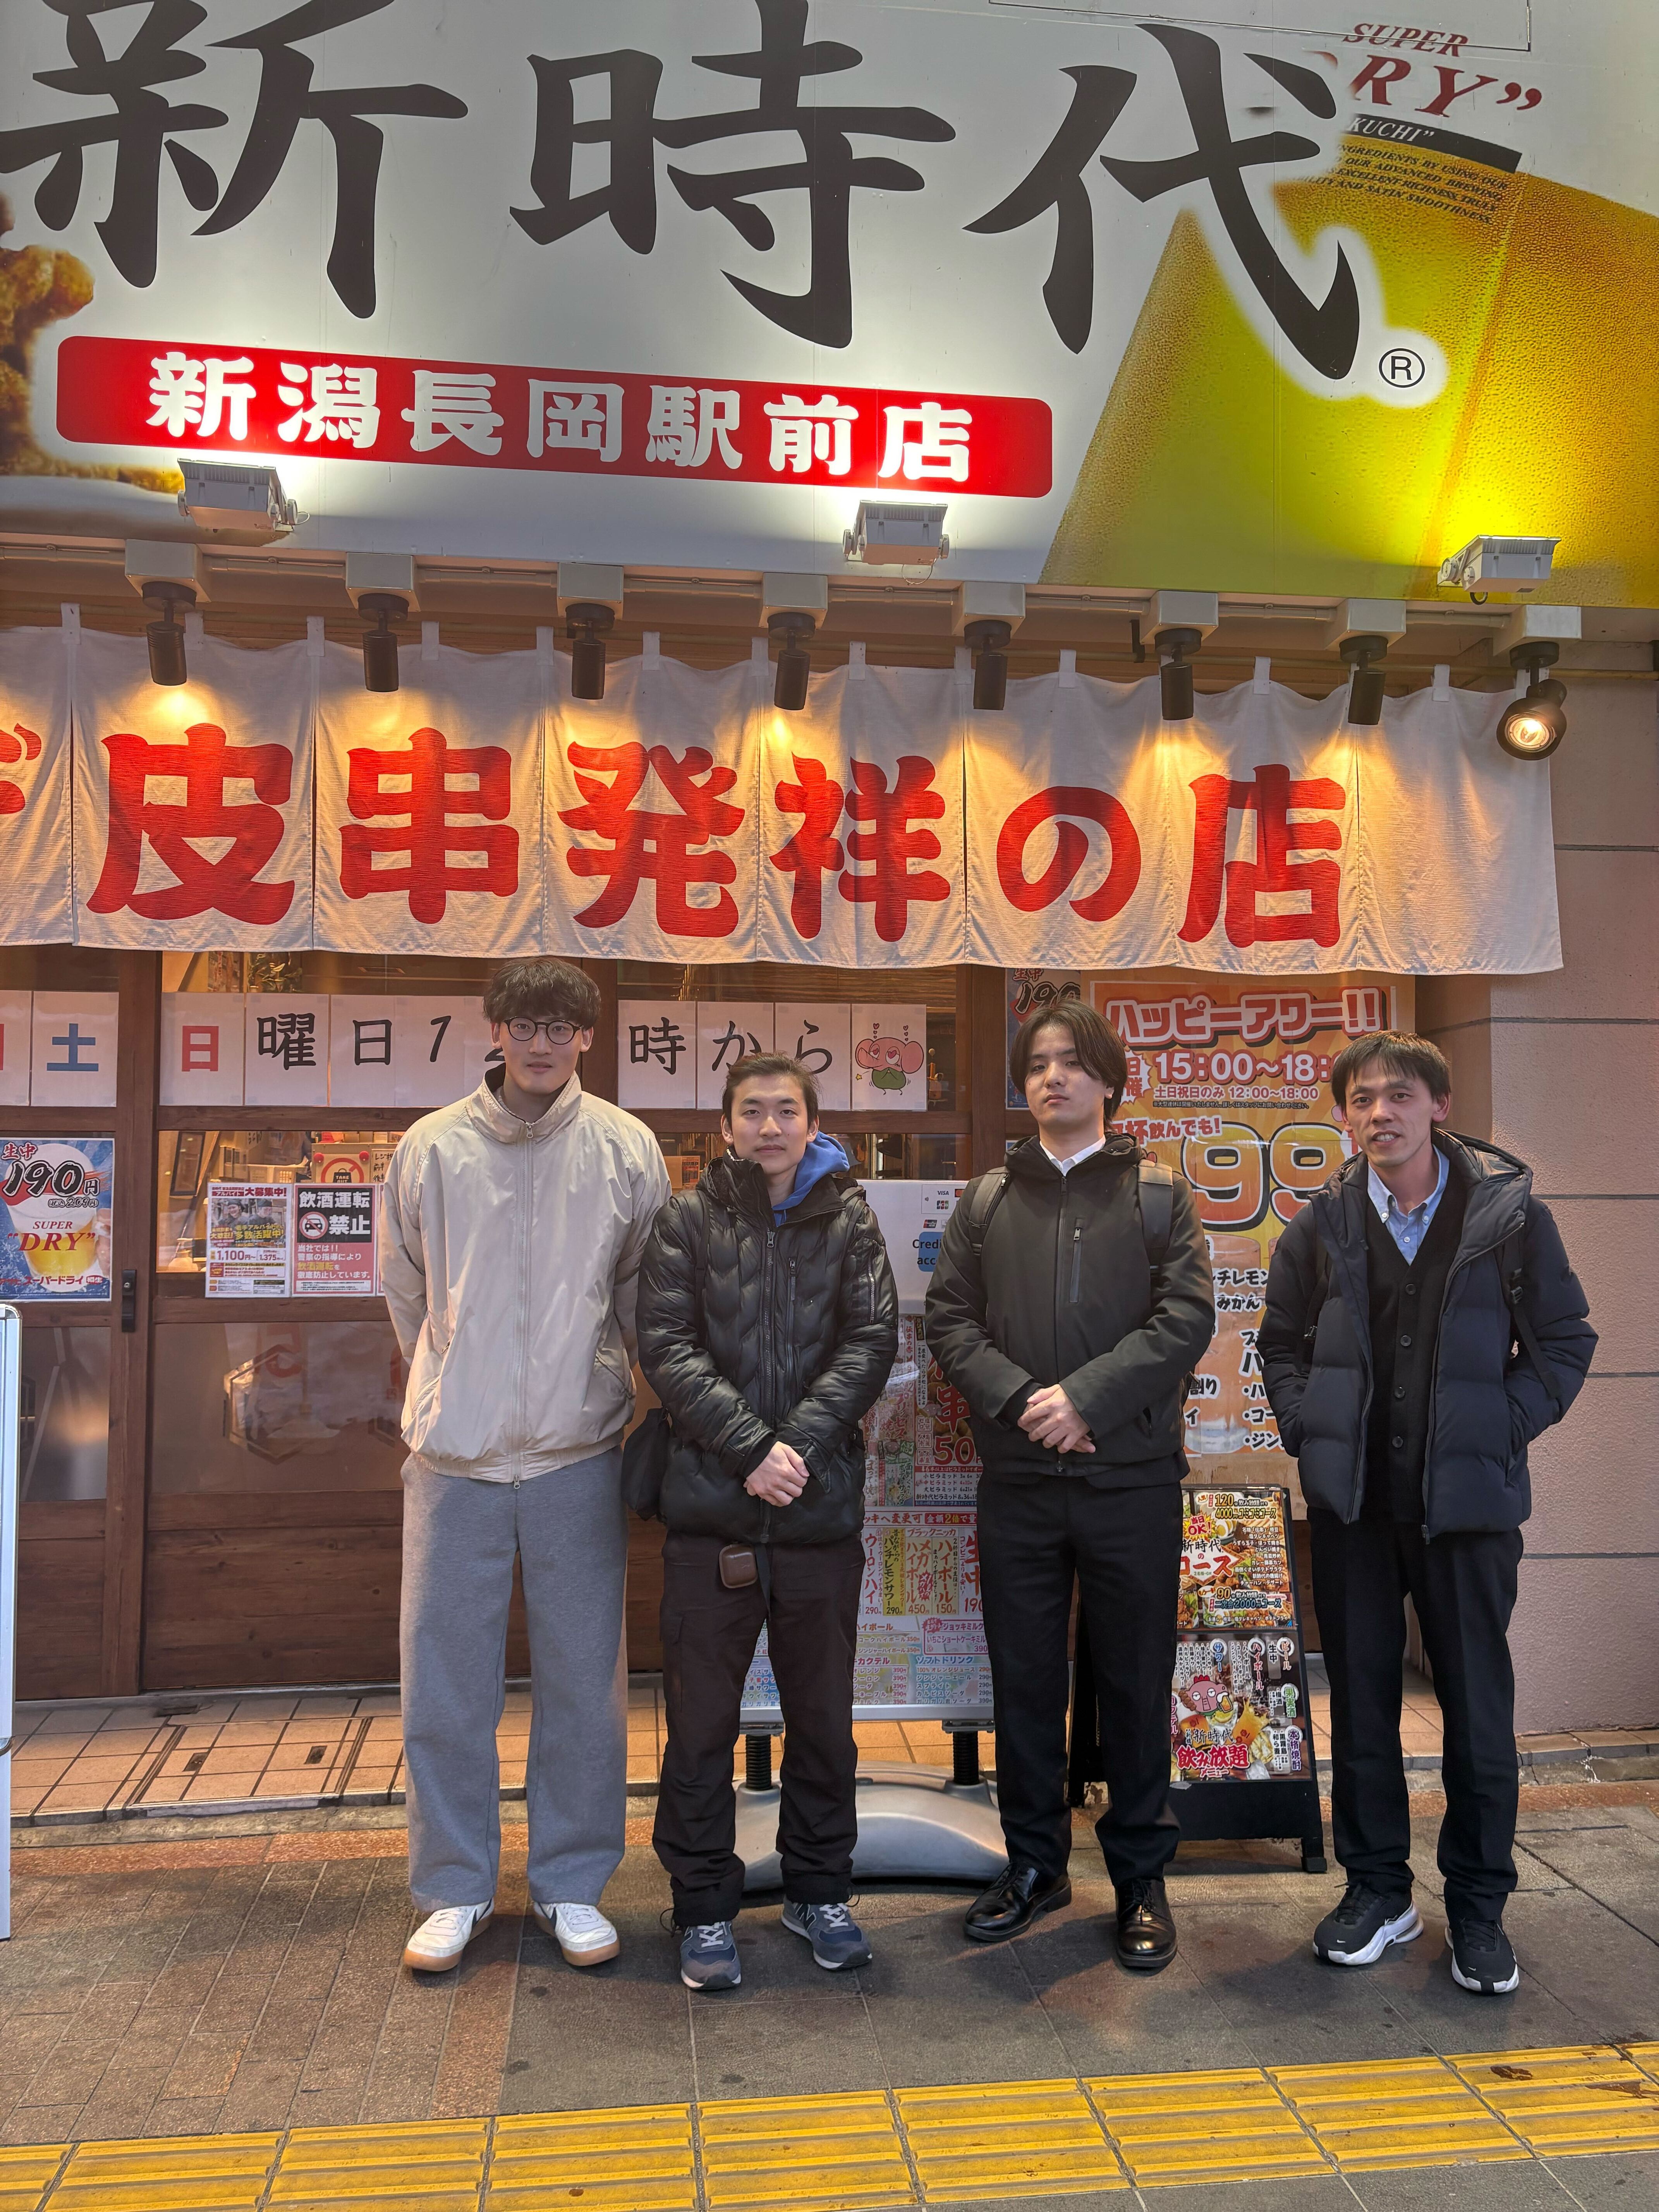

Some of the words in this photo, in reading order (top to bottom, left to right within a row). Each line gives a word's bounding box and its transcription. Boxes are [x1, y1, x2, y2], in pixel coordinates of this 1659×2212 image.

[1343, 23, 1468, 57] SUPER
[1306, 50, 1542, 118] RY”
[1336, 167, 1403, 185] EXCELLENT
[1345, 157, 1371, 167] OUR
[1374, 163, 1442, 182] ADVANCED
[0, 0, 1360, 380] 新時代
[1338, 179, 1364, 190] AND
[1366, 184, 1404, 198] SATIN
[146, 351, 972, 484] 新潟長岡駅前店
[1154, 1086, 1224, 1099] 土日祝日のみ
[1, 1143, 38, 1160] 生中
[3, 1160, 101, 1197] 190円
[244, 1187, 287, 1197] 大募集中!
[299, 1191, 370, 1208] 飲酒運転
[33, 1221, 73, 1230] SUPER
[329, 1214, 371, 1235] 禁止
[912, 1238, 941, 1249] Credi
[917, 1257, 937, 1265] acc
[23, 1276, 84, 1285] スーパードライ
[1213, 1269, 1268, 1286] チレモン
[1217, 1294, 1260, 1310] みかん
[934, 1436, 981, 1465] 50
[1188, 1522, 1212, 1535] OK!
[1190, 1516, 1205, 1525] 当日
[908, 1528, 957, 1537] ブラックニッカ
[864, 1533, 878, 1604] ウーロンハイ
[883, 1535, 895, 1606] パンチレモンサワー
[938, 1539, 954, 1603] ハイボール
[916, 1656, 974, 1665] ソフトドリンク
[1213, 1642, 1223, 1673] サワー
[1242, 1645, 1252, 1680] ハイボール
[1268, 1644, 1278, 1664] 生中
[1281, 1641, 1292, 1671] ビール
[1252, 1643, 1264, 1690] ハイボール
[1285, 1687, 1297, 1718] 果実酒
[1193, 1728, 1233, 1745] 新時代
[1176, 1743, 1250, 1769] 飲み放題
[1289, 1729, 1302, 1771] 本格焼酎
[1199, 1767, 1229, 1778] メニュー
